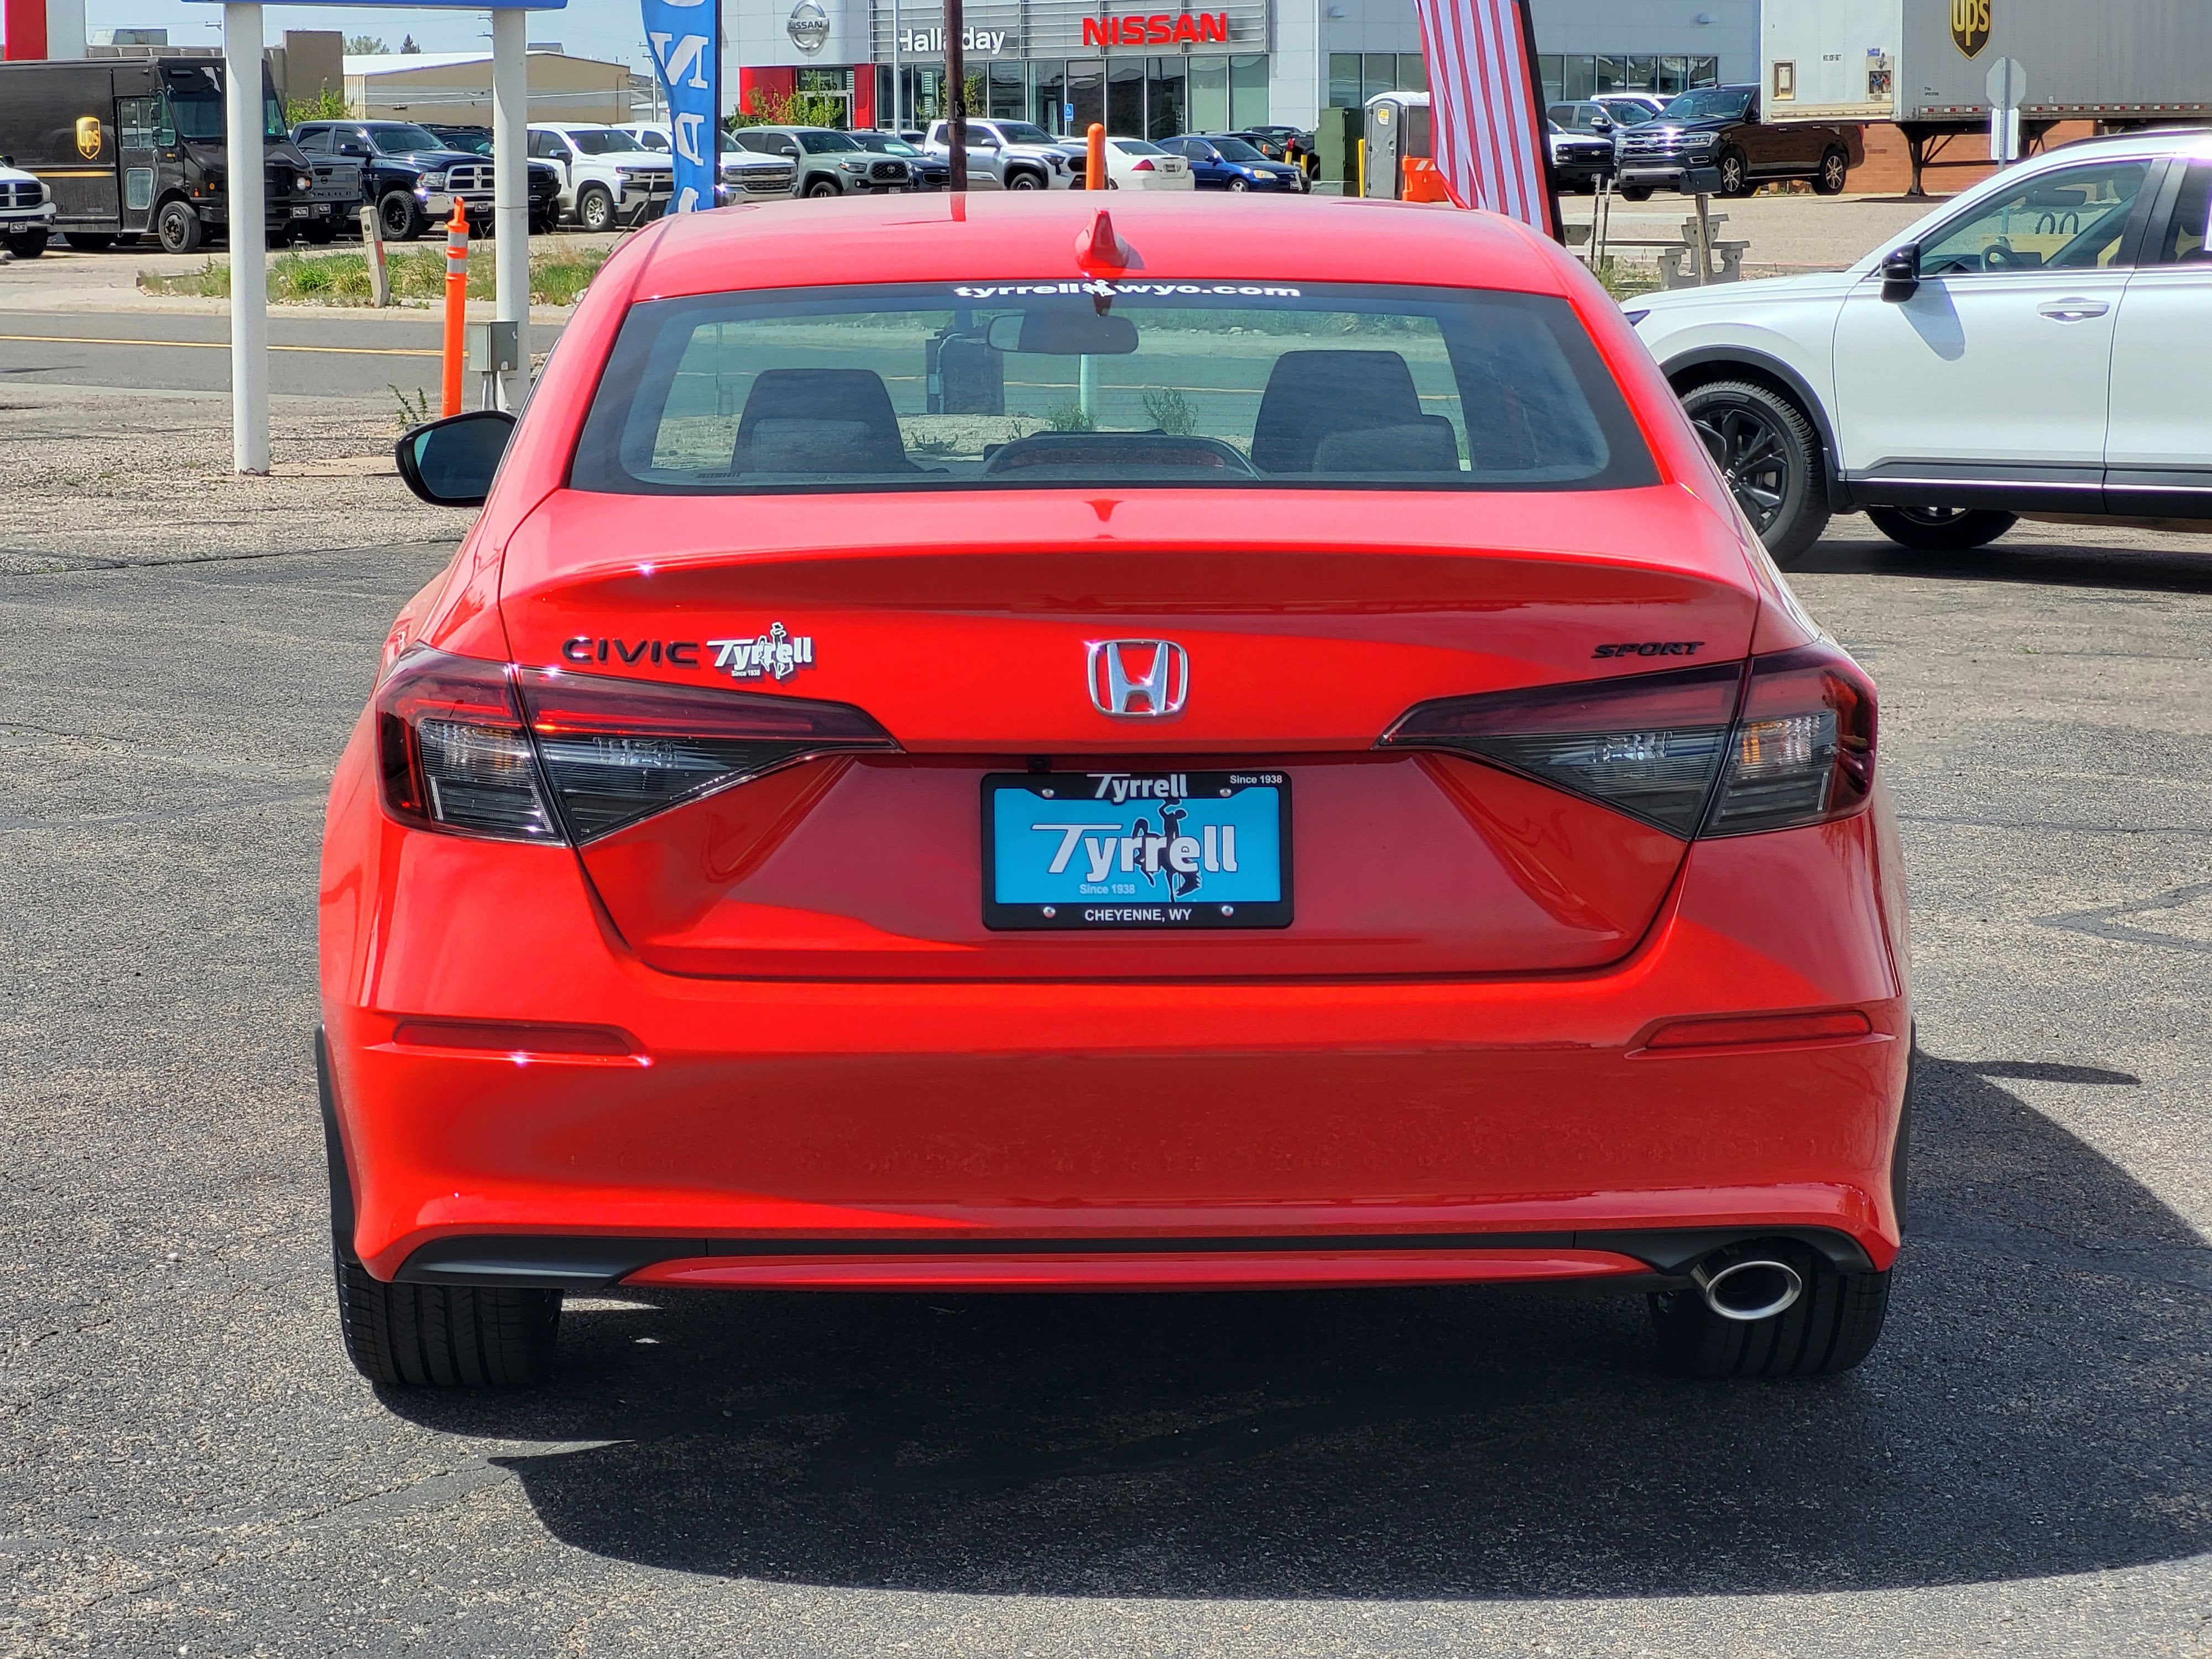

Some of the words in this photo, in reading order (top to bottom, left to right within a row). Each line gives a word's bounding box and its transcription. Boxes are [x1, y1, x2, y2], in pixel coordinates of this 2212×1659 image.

[1083, 12, 1227, 46] NISSAN
[1953, 0, 1989, 46] ups
[899, 27, 1006, 54] Hallday
[79, 129, 99, 153] ups
[953, 283, 1080, 298] tyrrell
[1114, 285, 1301, 296] wyo.com
[562, 637, 698, 664] CIVIC
[706, 637, 812, 670] Tyrrell
[1590, 641, 1705, 659] SPORT
[1086, 774, 1188, 803] Tyrrell
[1229, 775, 1258, 784] Since
[1260, 775, 1282, 784] 1938
[1032, 824, 1239, 883] Tyrrell
[1079, 884, 1109, 894] Since
[1112, 884, 1136, 894] 1938
[1084, 909, 1165, 922] CHEYENNE,
[1168, 909, 1192, 920] WY
